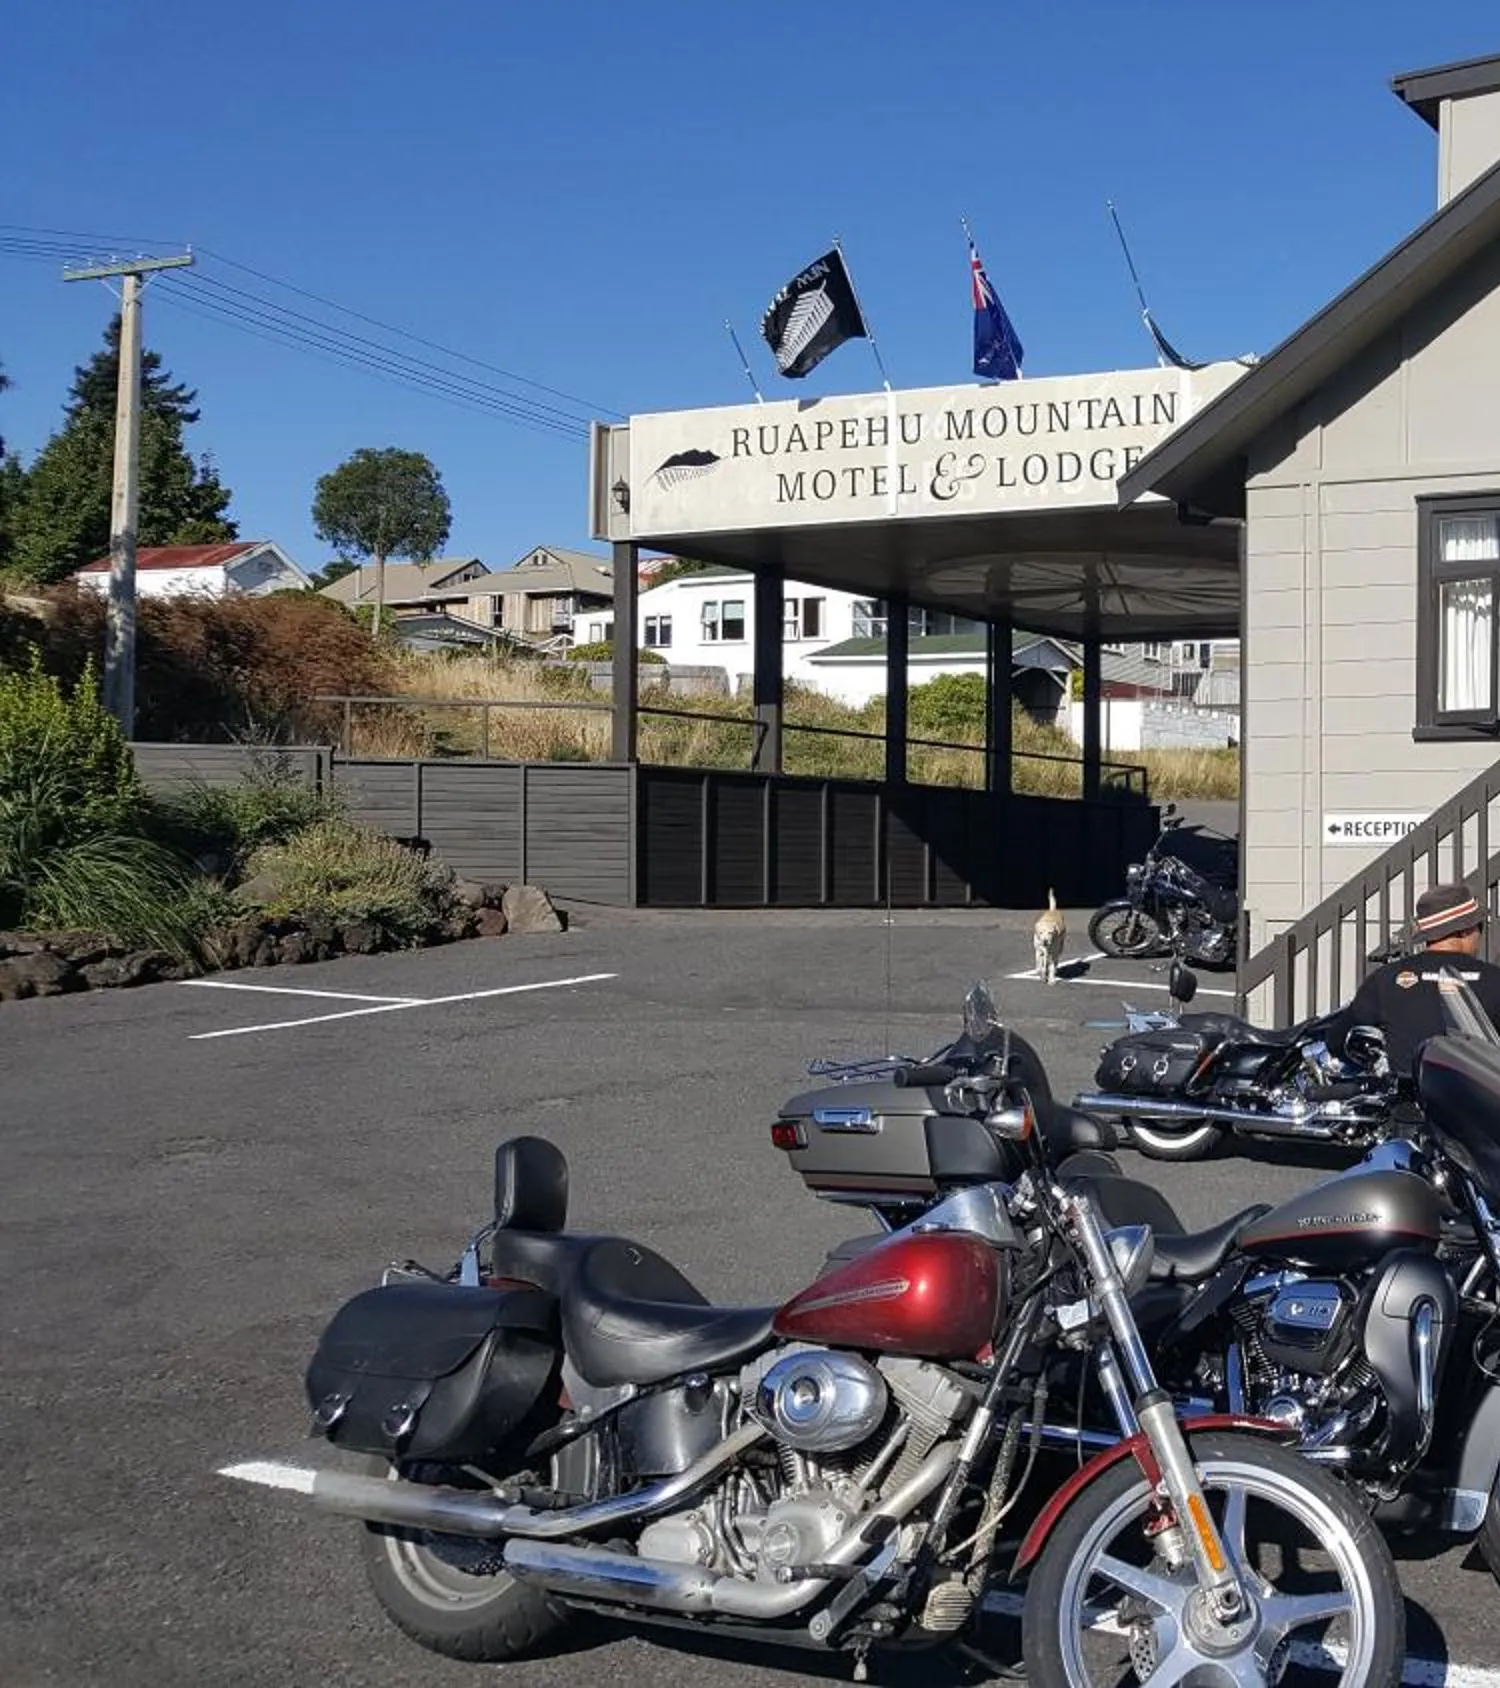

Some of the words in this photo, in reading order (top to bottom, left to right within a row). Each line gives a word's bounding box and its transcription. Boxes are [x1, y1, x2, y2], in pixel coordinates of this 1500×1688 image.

[731, 413, 922, 457] RUAPEHU
[944, 391, 1178, 441] MOUNTAIN
[776, 464, 917, 502] MOTEL
[930, 451, 986, 501] &
[996, 446, 1143, 487] LODGE
[1343, 821, 1421, 837] RECEPTIO
